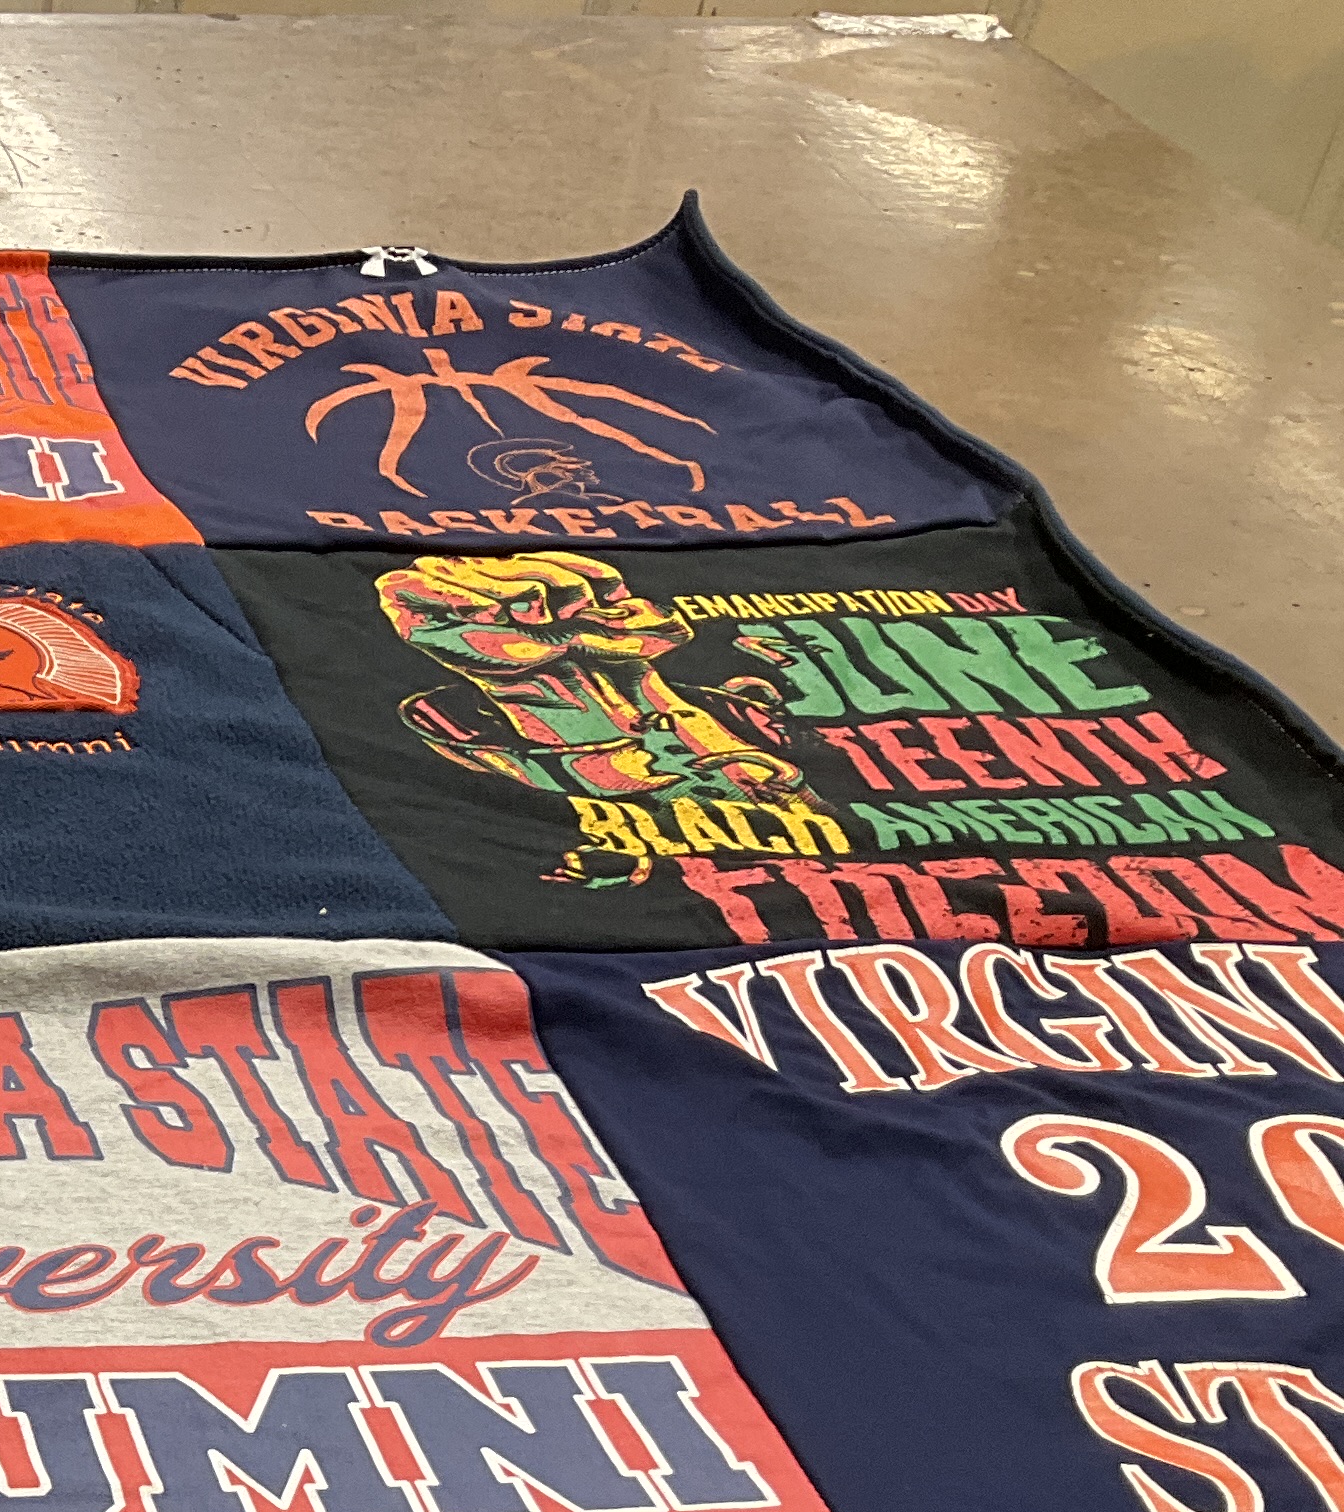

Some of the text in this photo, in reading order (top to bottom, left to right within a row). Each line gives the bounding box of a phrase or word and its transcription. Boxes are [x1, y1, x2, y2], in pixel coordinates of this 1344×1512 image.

[169, 290, 483, 391] VIRGINIA
[672, 586, 1028, 620] EMANCIPATION DAY
[732, 614, 1153, 719] JUNE
[816, 711, 1229, 792] TEENTH
[567, 789, 1276, 857] BLACK AMERICAN
[91, 969, 693, 1299] STATE
